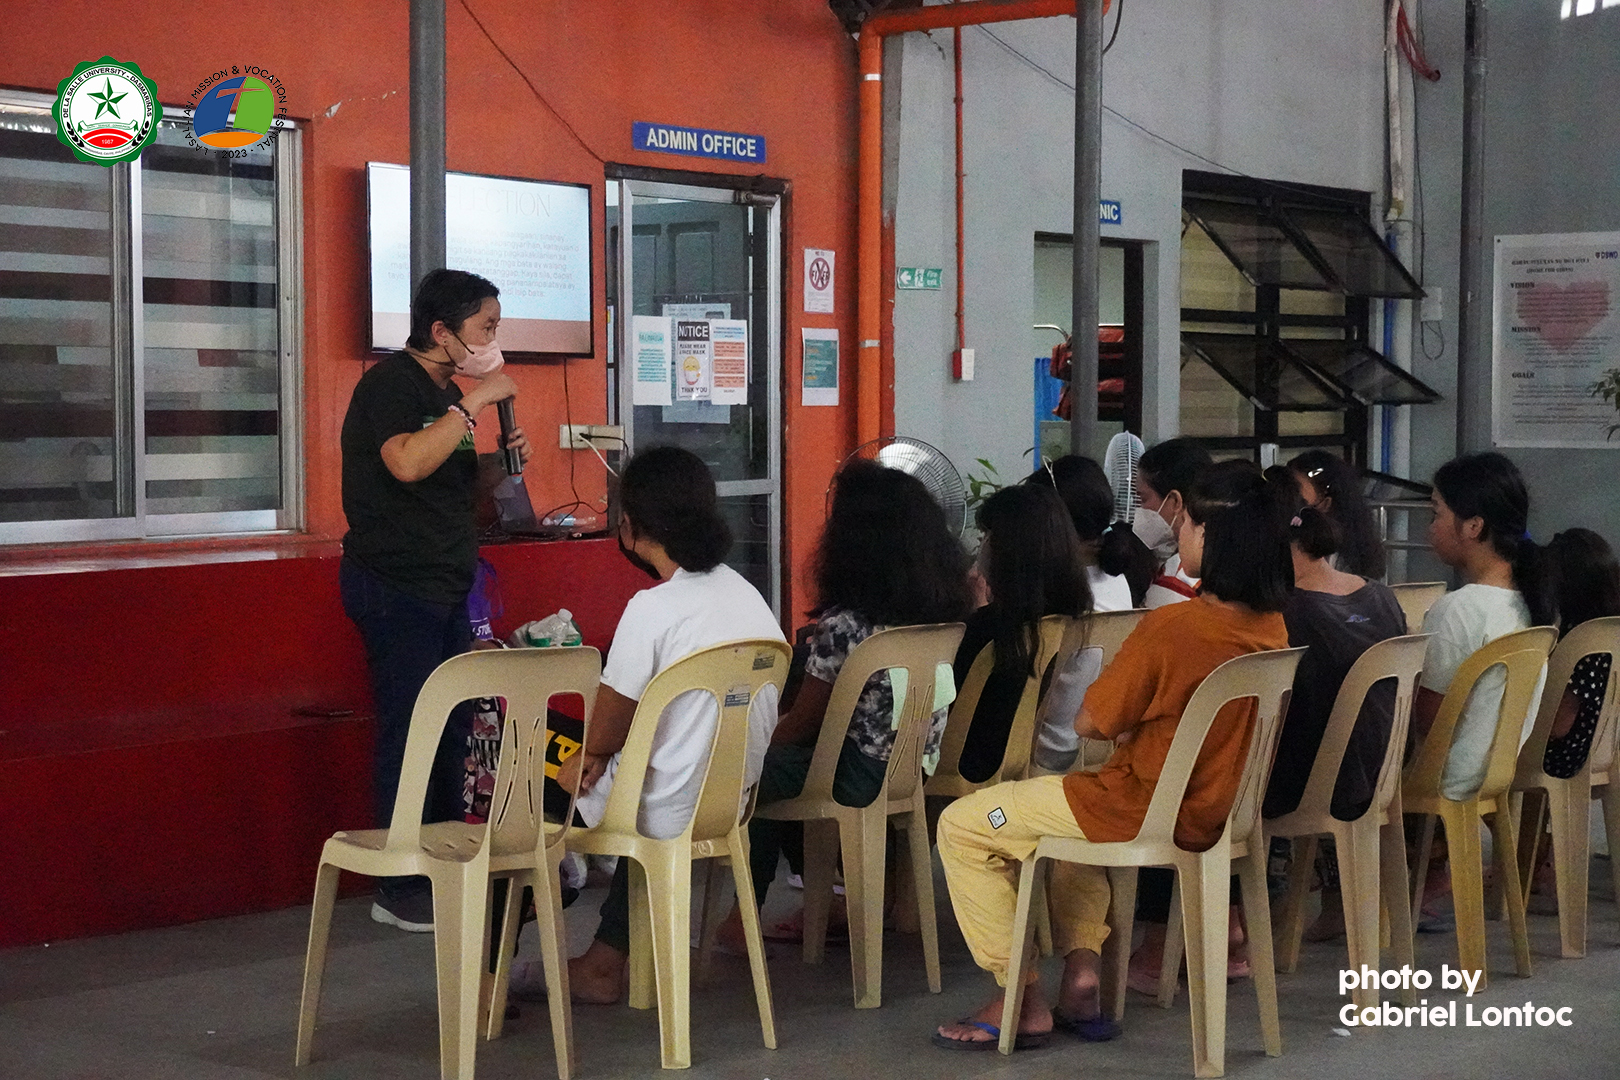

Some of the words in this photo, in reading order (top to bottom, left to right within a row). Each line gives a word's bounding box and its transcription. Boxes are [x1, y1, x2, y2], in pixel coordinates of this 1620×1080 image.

[646, 127, 698, 151] ADMIN
[701, 133, 757, 158] OFFICE
[516, 259, 533, 268] bata
